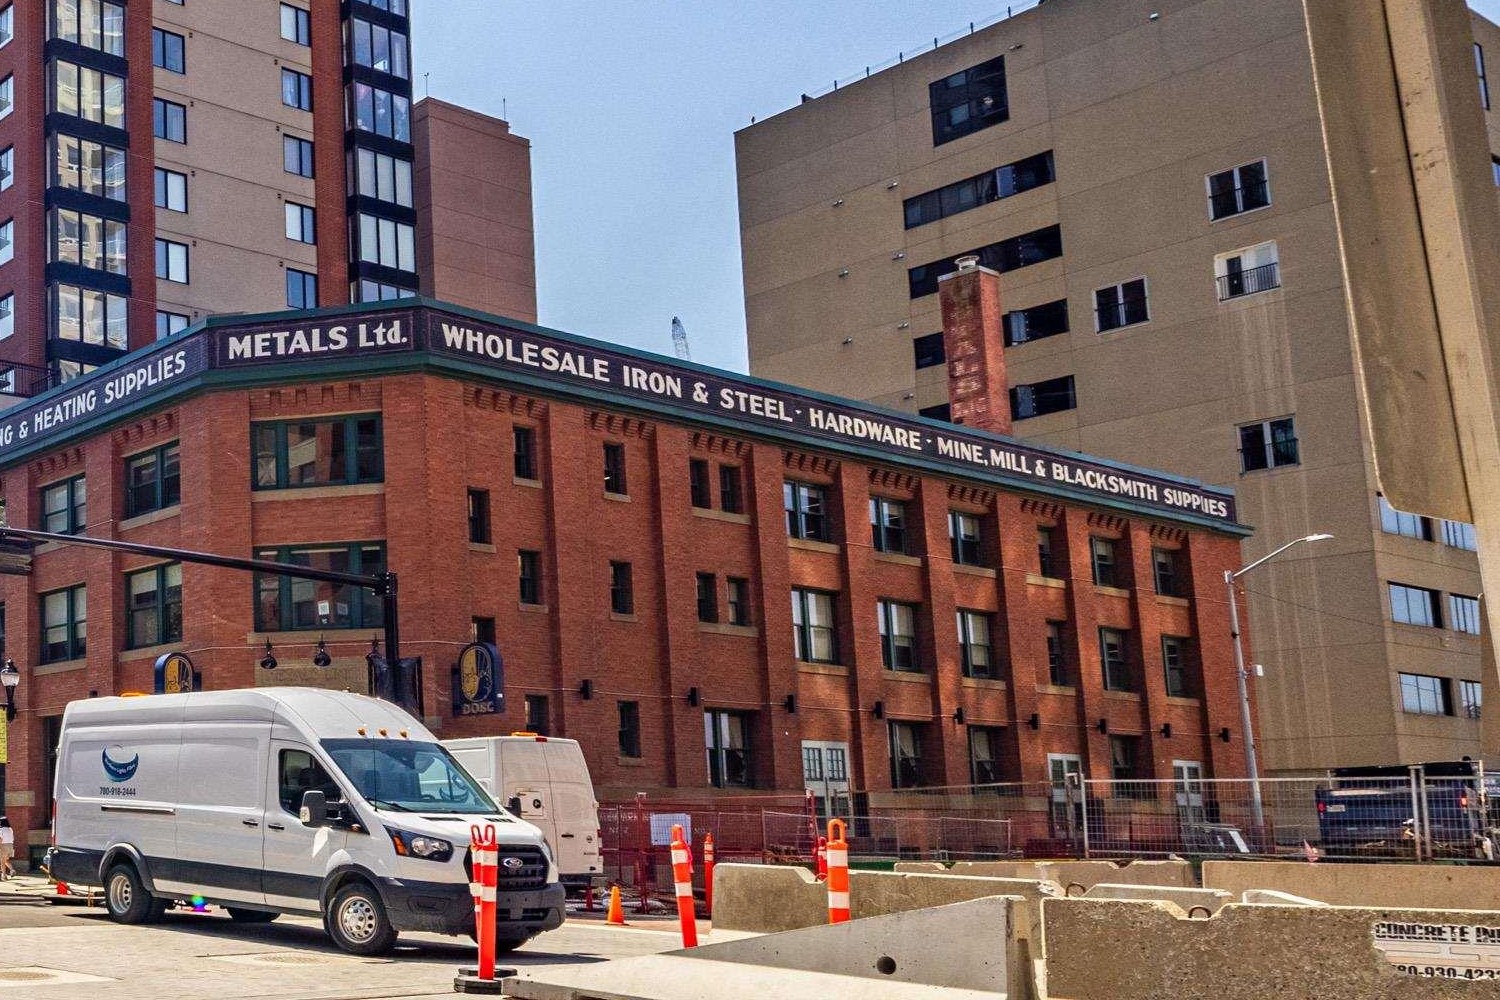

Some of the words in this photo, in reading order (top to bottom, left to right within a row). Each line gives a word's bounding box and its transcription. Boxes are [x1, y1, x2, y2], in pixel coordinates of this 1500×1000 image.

[228, 326, 348, 360] METALS
[358, 320, 408, 348] Ltd.
[19, 421, 29, 439] &
[34, 389, 97, 433] HEATING
[104, 350, 186, 404] SUPPLIES
[441, 323, 610, 383] WHOLESALE
[622, 365, 682, 398] IRON
[692, 381, 709, 404] &
[719, 387, 793, 422] STEEL
[809, 408, 923, 451] HARDWARE
[937, 437, 989, 466] MINE,
[991, 449, 1032, 475] MILL
[1035, 459, 1046, 477] &
[1052, 462, 1158, 501] BLACKSMITH
[1163, 488, 1228, 517] SUPPLIES
[1375, 923, 1470, 942] CONCRETE
